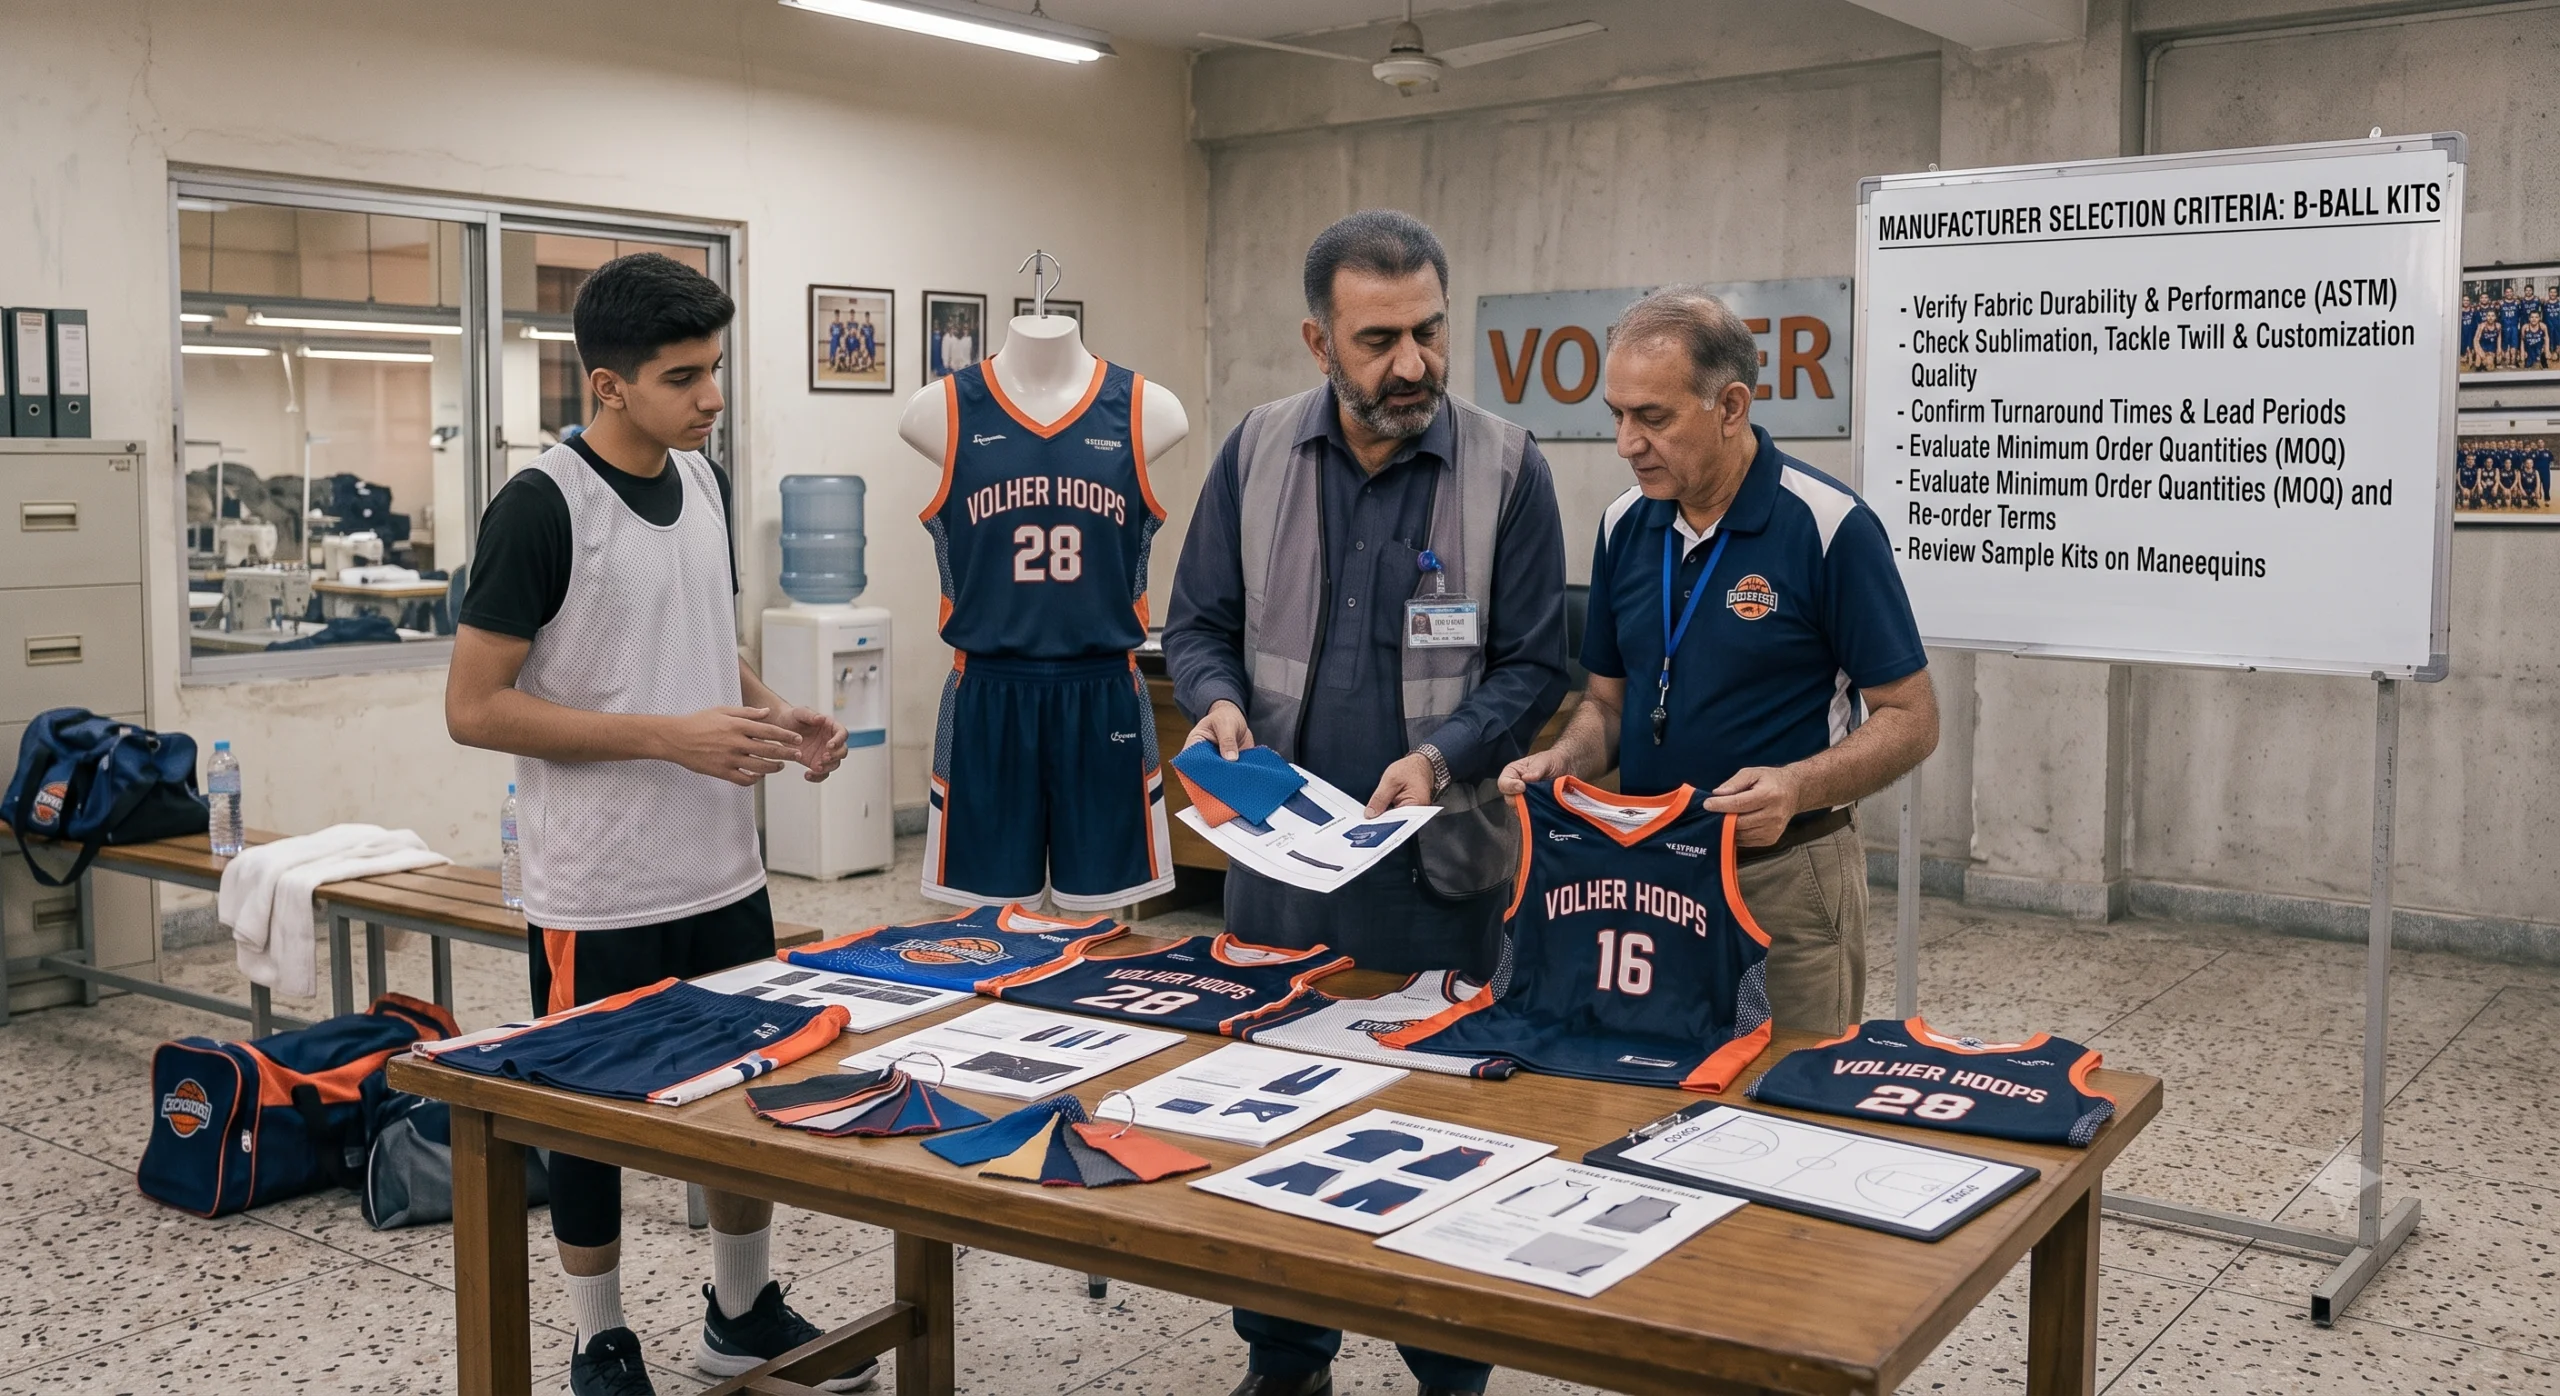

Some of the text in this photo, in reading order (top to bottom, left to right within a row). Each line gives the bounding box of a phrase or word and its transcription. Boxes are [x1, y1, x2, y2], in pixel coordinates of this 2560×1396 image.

[1879, 182, 2441, 242] MANUFACTURER SELECTION CRITERIA: B-BALL KITS
[1913, 293, 1968, 324] Verify
[1974, 291, 2033, 318] Fabric
[2040, 288, 2138, 320] Durability
[2144, 286, 2160, 313] &
[2167, 284, 2306, 312] Performance
[2314, 277, 2397, 315] (ASTM)
[1487, 314, 1835, 405] VOER
[1913, 329, 1970, 354] Check
[1975, 326, 2098, 356] Sublimation,
[2104, 324, 2170, 352] Tackle
[2176, 323, 2225, 350] Twill
[2232, 322, 2248, 350] &
[2256, 319, 2415, 349] Customization
[1911, 362, 1978, 393] Quality
[1911, 398, 1985, 423] Confirm
[1990, 398, 2104, 424] Turnaround
[2109, 398, 2173, 425] Times
[2179, 398, 2196, 425] &
[2203, 398, 2255, 425] Lead
[2263, 397, 2346, 425] Periods
[1910, 433, 1990, 459] Evaluate
[1997, 434, 2089, 460] Minimum
[2095, 435, 2154, 462] Order
[2159, 436, 2267, 464] Quantities
[2275, 437, 2346, 470] (MOQ)
[967, 476, 1126, 526] VOLHER HOOPS
[1909, 468, 1990, 494] Evaluate
[1996, 470, 2088, 497] Minimum
[2095, 472, 2153, 499] Order
[2158, 473, 2266, 503] Quantities
[2273, 475, 2343, 511] (MOQ)
[2351, 478, 2393, 506] and
[1908, 501, 2056, 531] Re-order Terms
[1013, 524, 1082, 582] 28
[1908, 536, 1976, 563] Review
[1981, 539, 2055, 572] Sample
[2061, 542, 2098, 570] Kits
[2105, 550, 2129, 571] on
[2137, 546, 2266, 582] Maneequins
[1545, 879, 1707, 938] VOLHER HOOPS
[1596, 928, 1656, 996] 16
[1076, 984, 1200, 1016] 28
[1103, 968, 1257, 1001] VOLHER HOOPS
[1832, 1059, 2049, 1105] VOLHER HOOPS
[1855, 1084, 1976, 1121] 28
